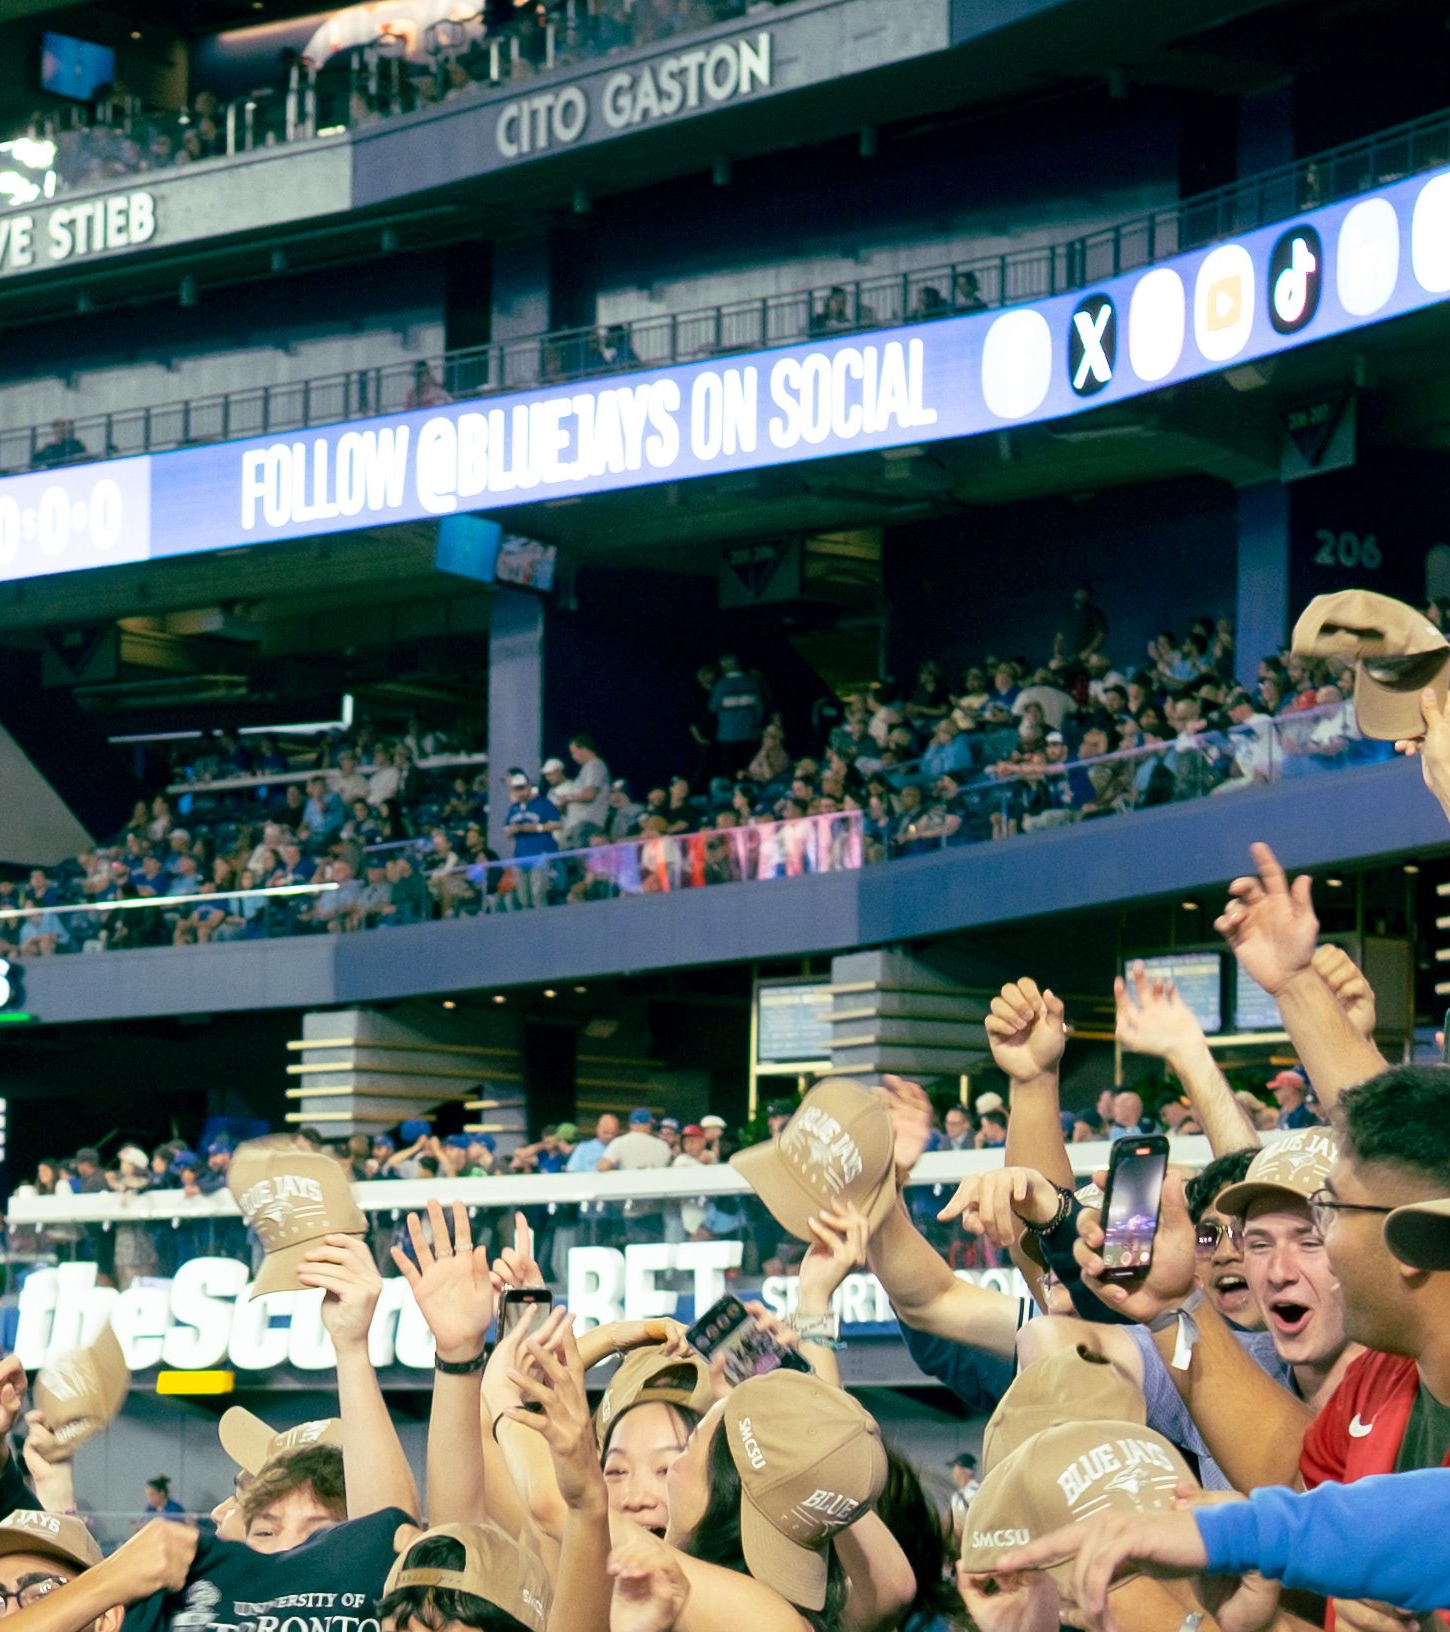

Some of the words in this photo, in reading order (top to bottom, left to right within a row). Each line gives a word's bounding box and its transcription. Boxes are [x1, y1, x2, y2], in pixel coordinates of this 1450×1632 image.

[495, 95, 588, 159] CITO
[602, 31, 773, 130] GASTON
[47, 192, 158, 262] STIEB
[240, 425, 409, 532] FOLLOW
[415, 377, 680, 512] @BLUEJAYS
[690, 366, 757, 462] ON
[768, 337, 938, 450] SOCIAL
[1313, 529, 1383, 570] 206
[1305, 1134, 1340, 1163] JAY
[272, 1174, 324, 1202] JAYS
[739, 1416, 768, 1470] SMCSU
[1057, 1442, 1121, 1507] BLUE
[1115, 1438, 1176, 1472] JAYS
[801, 1488, 860, 1520] BLUE
[971, 1527, 1032, 1549] SMCSU
[340, 1592, 367, 1609] OF
